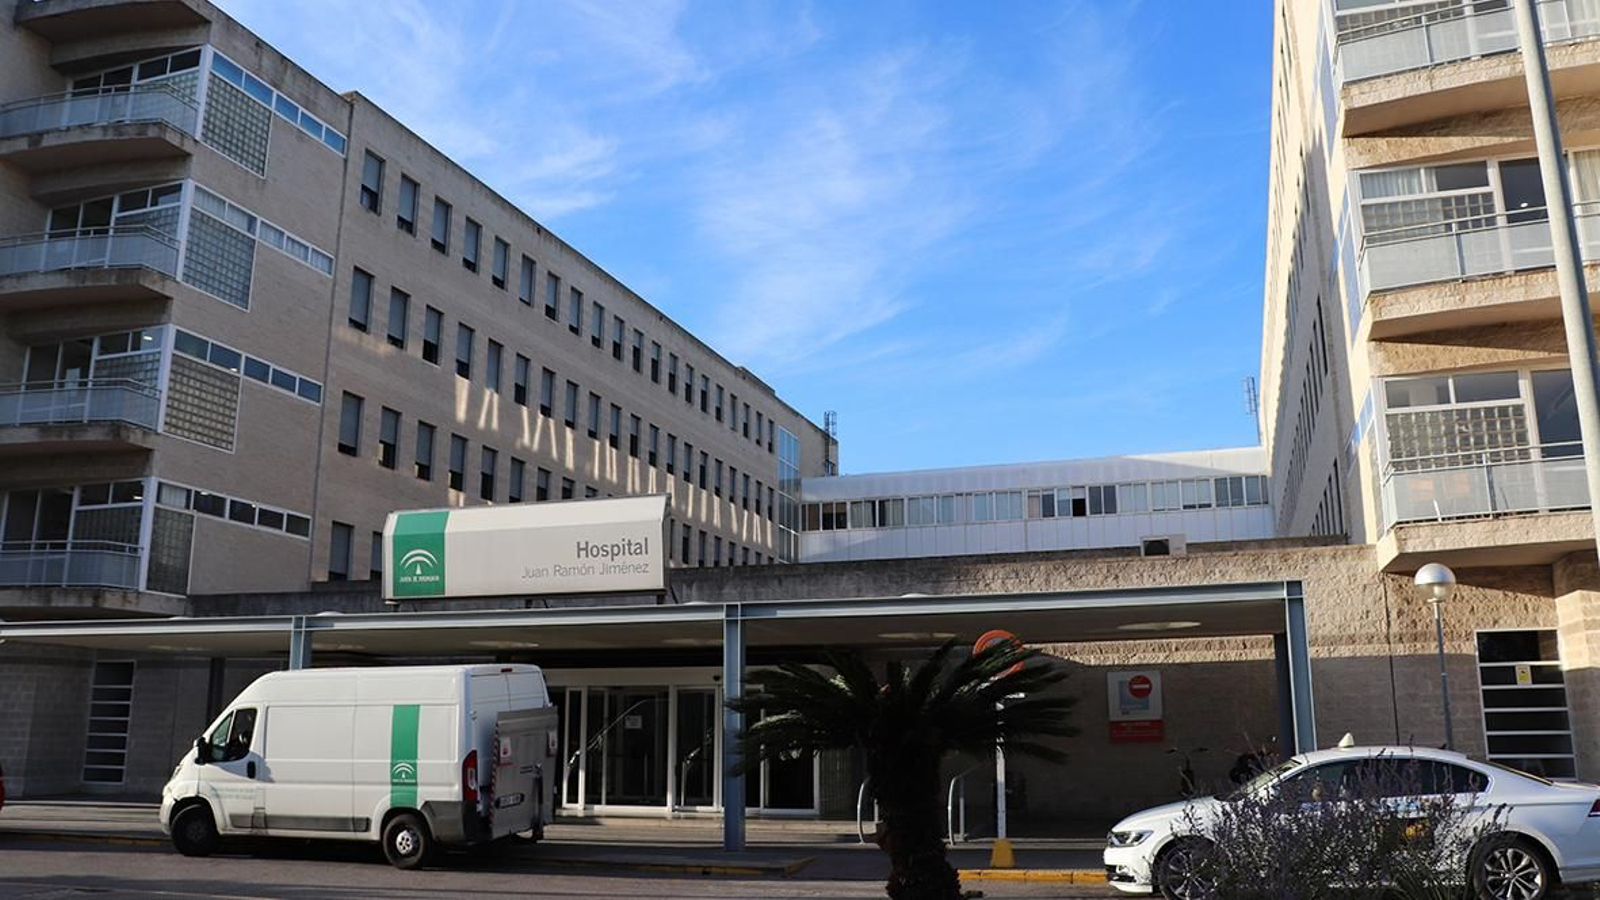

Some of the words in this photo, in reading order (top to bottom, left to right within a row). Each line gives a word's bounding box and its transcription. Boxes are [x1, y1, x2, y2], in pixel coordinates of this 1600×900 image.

[576, 537, 649, 561] Hospital
[521, 565, 549, 579] Juan
[553, 562, 595, 577] Ramón
